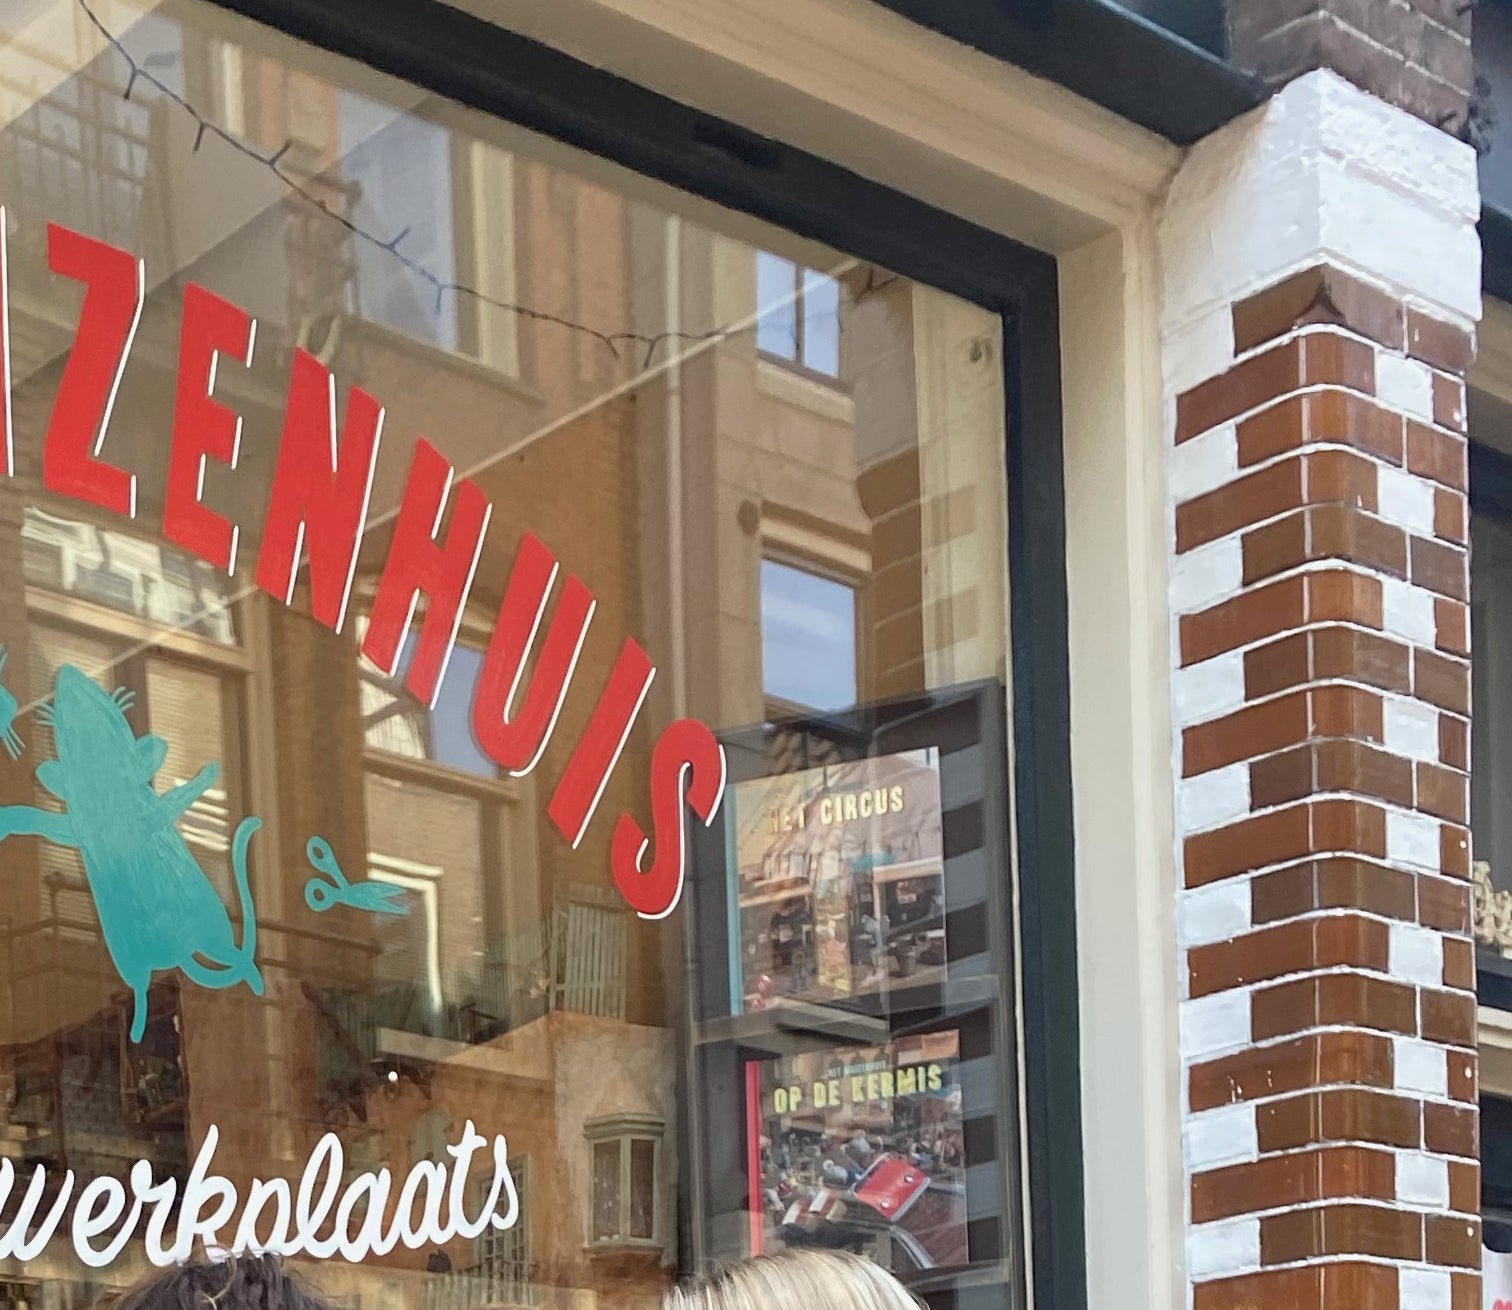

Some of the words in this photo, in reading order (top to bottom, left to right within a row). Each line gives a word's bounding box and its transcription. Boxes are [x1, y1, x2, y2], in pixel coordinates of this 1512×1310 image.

[820, 785, 904, 825] CIRCUS
[774, 1086, 802, 1114] OP
[813, 1080, 840, 1108] DE
[852, 1064, 942, 1102] KERMIS
